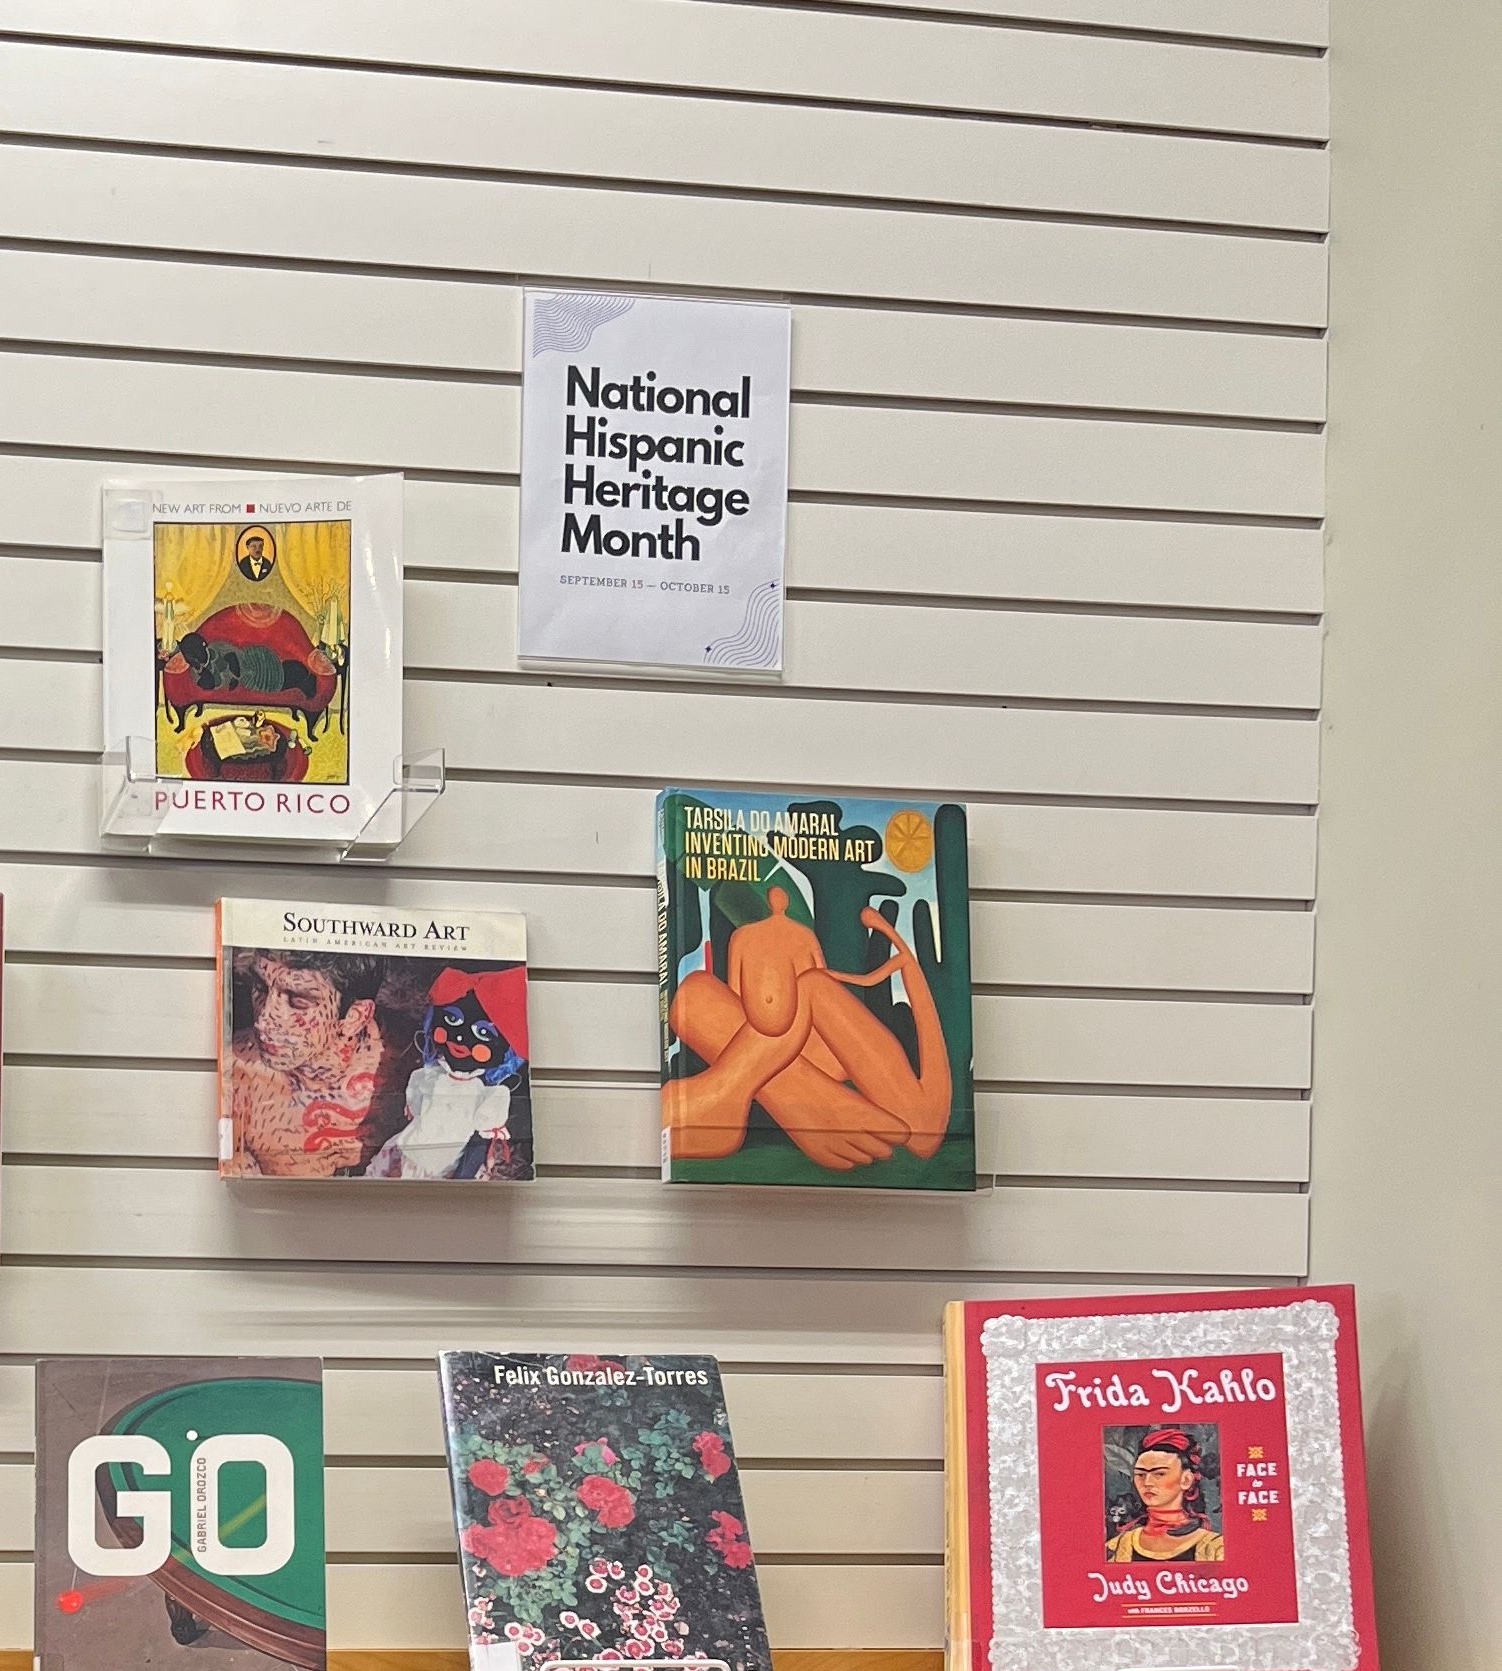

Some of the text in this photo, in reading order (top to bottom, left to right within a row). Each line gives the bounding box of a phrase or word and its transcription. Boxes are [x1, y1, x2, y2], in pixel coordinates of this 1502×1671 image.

[566, 365, 751, 419] National
[565, 414, 745, 472] Hispanic
[152, 503, 241, 514] NEW ART FROM
[259, 501, 352, 513] NUEVO ARTE DE
[564, 464, 750, 527] Heritage
[561, 512, 700, 561] Month
[560, 575, 730, 594] SEPTEMBER 15 OCTOBER 15
[155, 790, 350, 815] PUERTO RICO
[684, 807, 838, 836] TARSILA DO AMARAL
[685, 832, 874, 862] INVENTING MODERN ART
[685, 856, 762, 882] IN BRAZIL
[283, 913, 470, 941] SOUTHWARD ART
[494, 1365, 709, 1386] Felix Gonzalez-Torres
[1045, 1368, 1276, 1413] Frida Kahlo
[1237, 1462, 1278, 1477] FACE
[68, 1434, 295, 1576] GO
[196, 1457, 207, 1553] GABRIEL OROZCO
[1238, 1490, 1279, 1504] FACE
[1088, 1570, 1249, 1602] Judy Chicago
